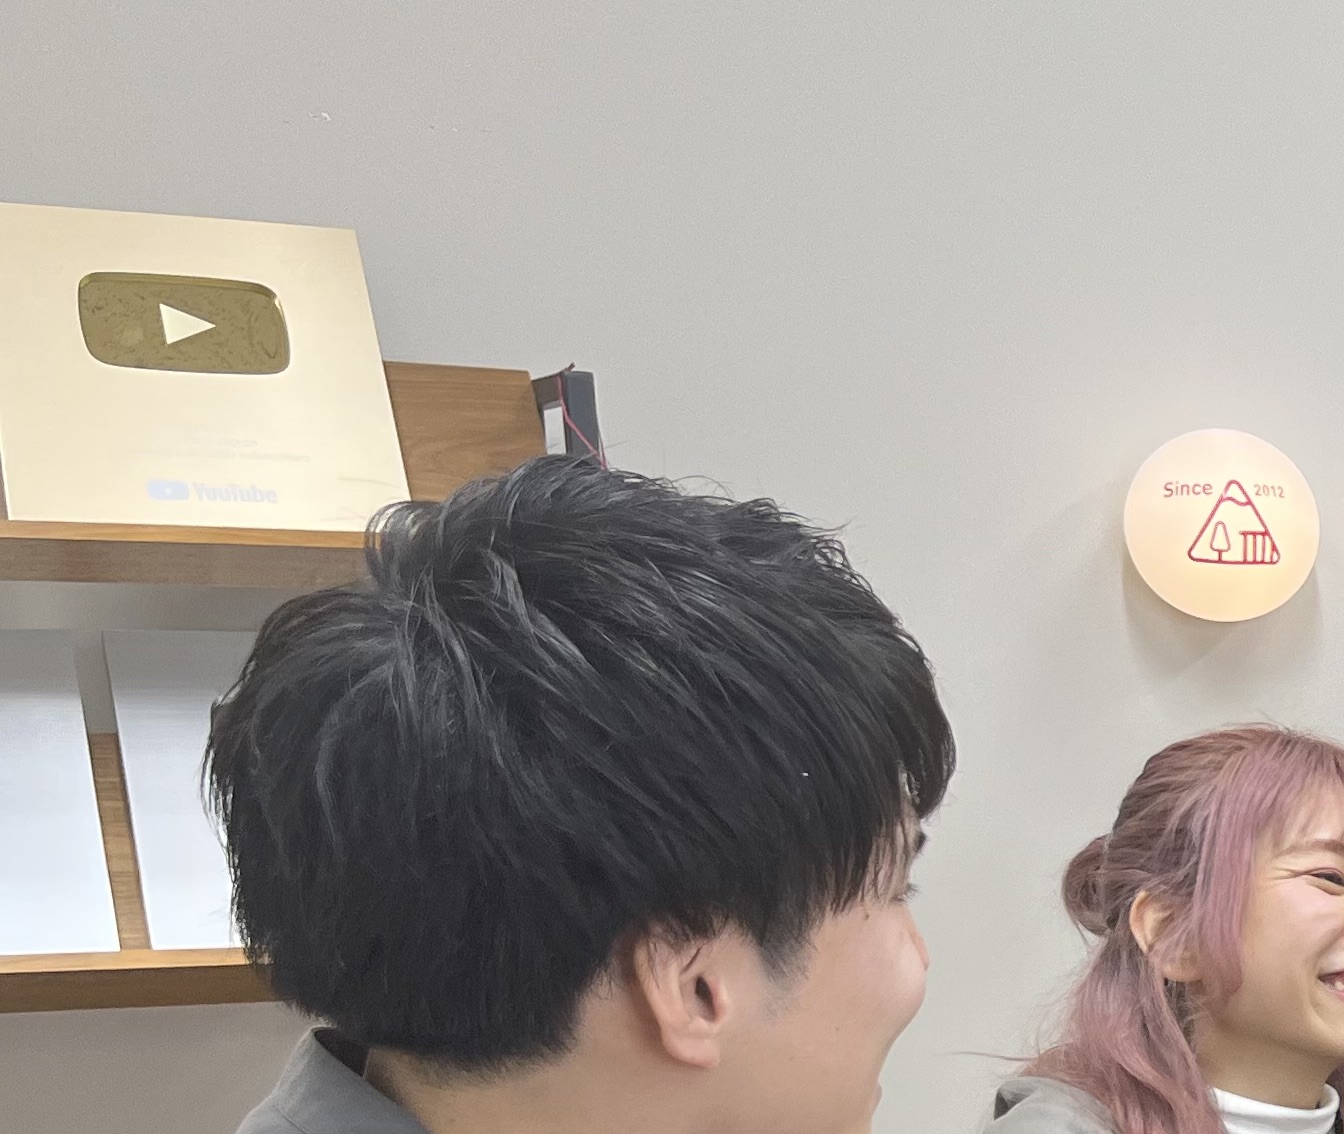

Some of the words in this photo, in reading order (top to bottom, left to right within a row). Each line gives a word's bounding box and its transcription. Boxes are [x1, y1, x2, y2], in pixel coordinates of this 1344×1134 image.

[192, 482, 278, 505] YouTube
[1163, 481, 1213, 498] Since
[1253, 483, 1285, 499] 2012
